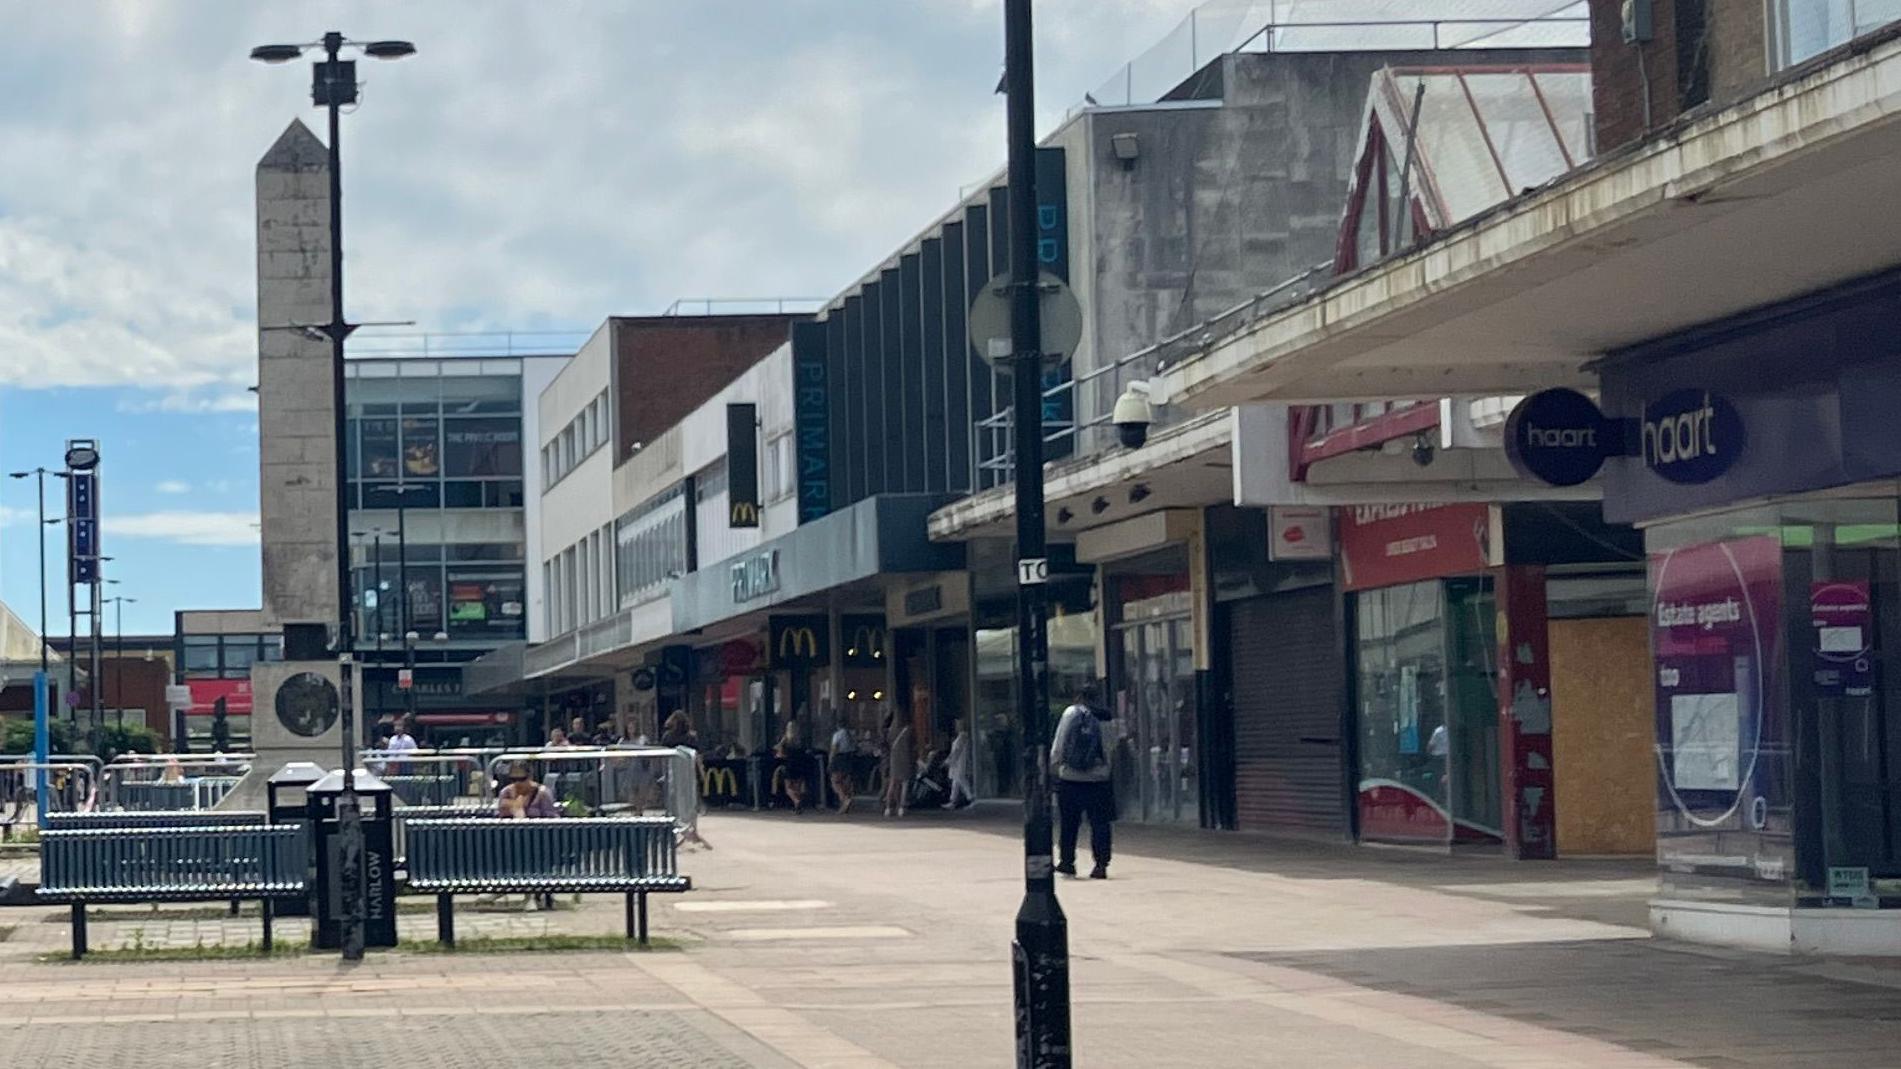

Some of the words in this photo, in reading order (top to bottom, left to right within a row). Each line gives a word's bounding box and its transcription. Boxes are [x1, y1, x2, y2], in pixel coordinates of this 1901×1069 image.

[1527, 421, 1597, 447] haart
[1642, 391, 1716, 467] haart
[1697, 596, 1740, 631] agents
[367, 851, 383, 920] HARLOW
